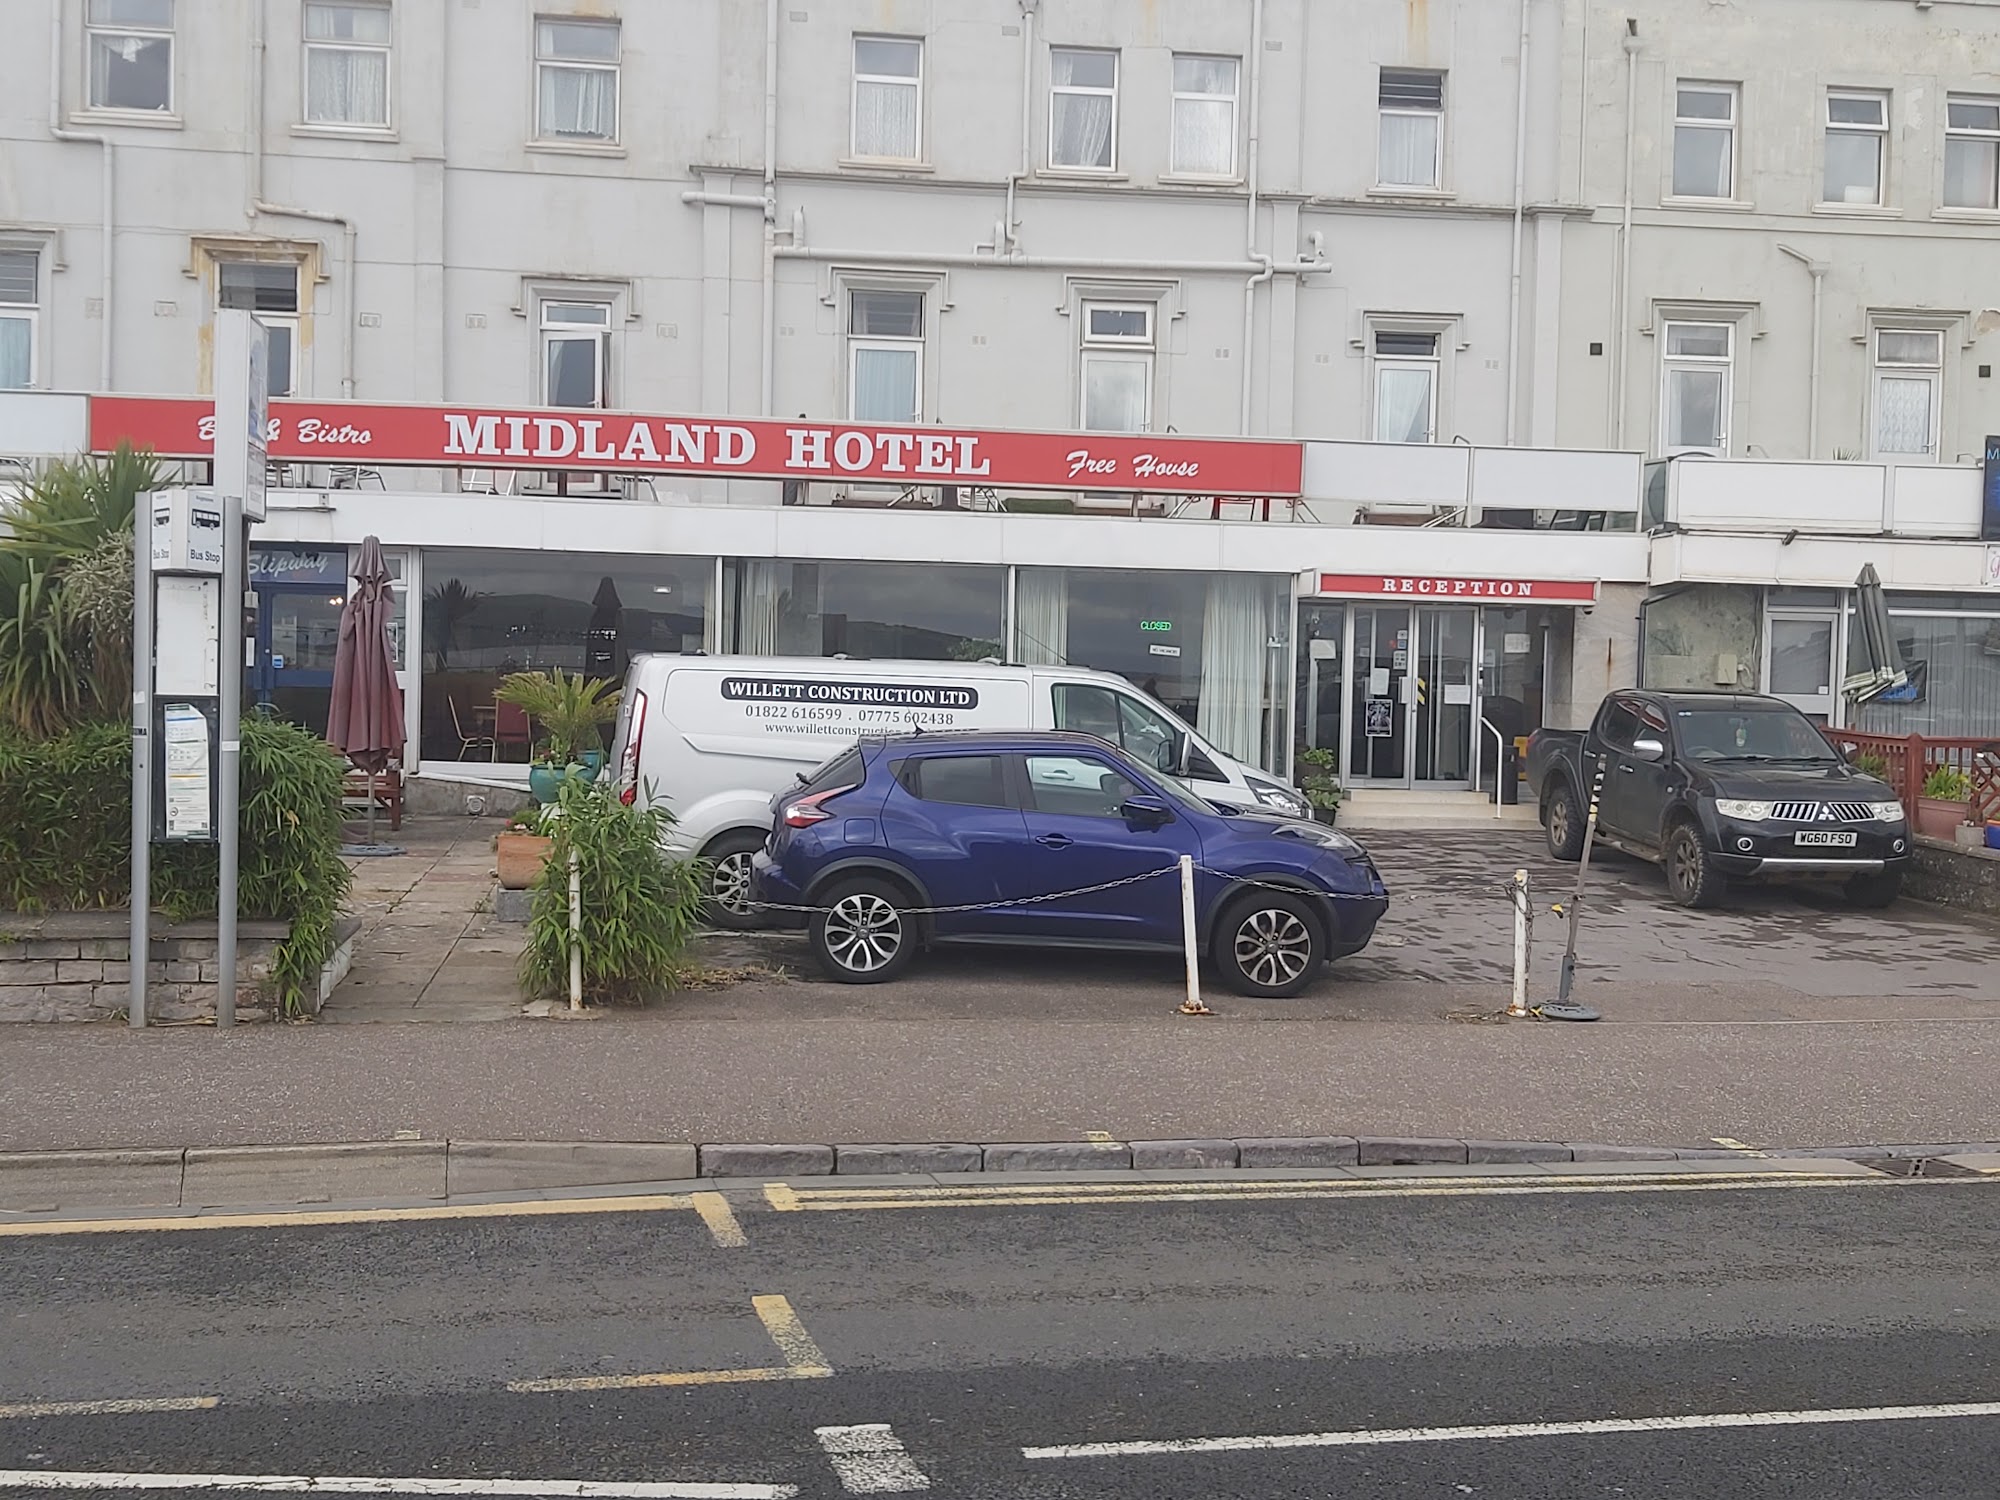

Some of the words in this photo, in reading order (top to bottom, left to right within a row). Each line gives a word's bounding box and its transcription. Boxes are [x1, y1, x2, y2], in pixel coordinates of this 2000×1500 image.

[297, 418, 372, 444] Bistro
[443, 414, 756, 465] MIDLAND
[785, 429, 991, 475] HOTEL
[1066, 450, 1117, 478] Free
[190, 549, 203, 560] Bus
[205, 551, 220, 564] Stop
[249, 554, 329, 577] Slipway
[1383, 578, 1533, 596] RECEPTION
[1140, 621, 1172, 631] CLOSED
[728, 682, 805, 698] WILLETT
[808, 685, 935, 704] CONSTRUCTION
[939, 691, 970, 705] LTD
[745, 705, 787, 718] 01822
[791, 707, 842, 720] 616599
[859, 710, 900, 722] 07775
[904, 712, 954, 725] 602438
[1800, 832, 1828, 843] WG60
[1830, 833, 1852, 844] FSO
